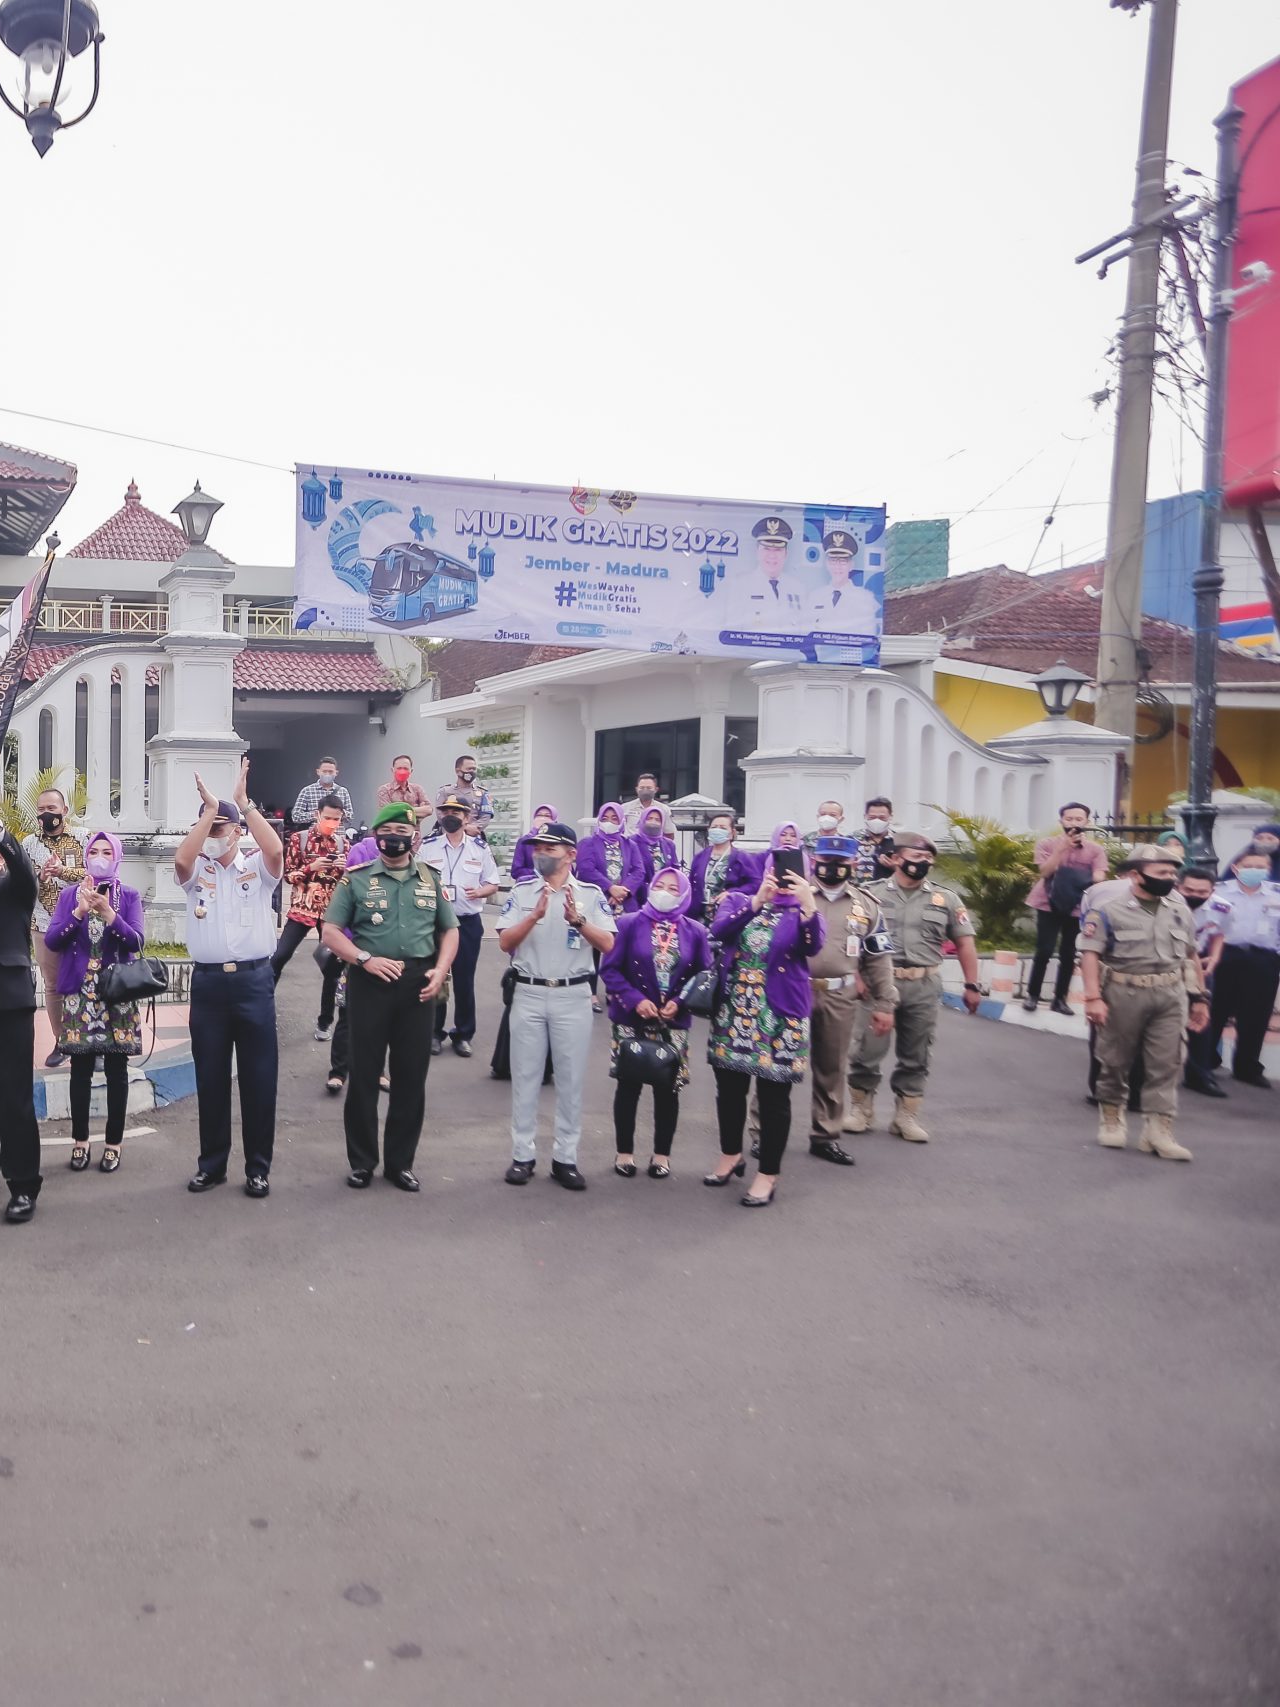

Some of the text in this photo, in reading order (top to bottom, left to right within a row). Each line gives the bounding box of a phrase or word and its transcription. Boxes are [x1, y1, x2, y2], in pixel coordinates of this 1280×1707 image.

[455, 509, 738, 555] MUDIK GRATIS 2022
[525, 555, 589, 573] Jember
[606, 561, 669, 578] Madura
[439, 577, 463, 591] MUDIK
[578, 581, 635, 592] WesWayahe
[438, 593, 465, 607] GRATIS
[577, 591, 637, 603] MudikGratis
[578, 601, 603, 611] Aman
[615, 604, 641, 614] Sehat
[495, 629, 530, 640] JEMBER
